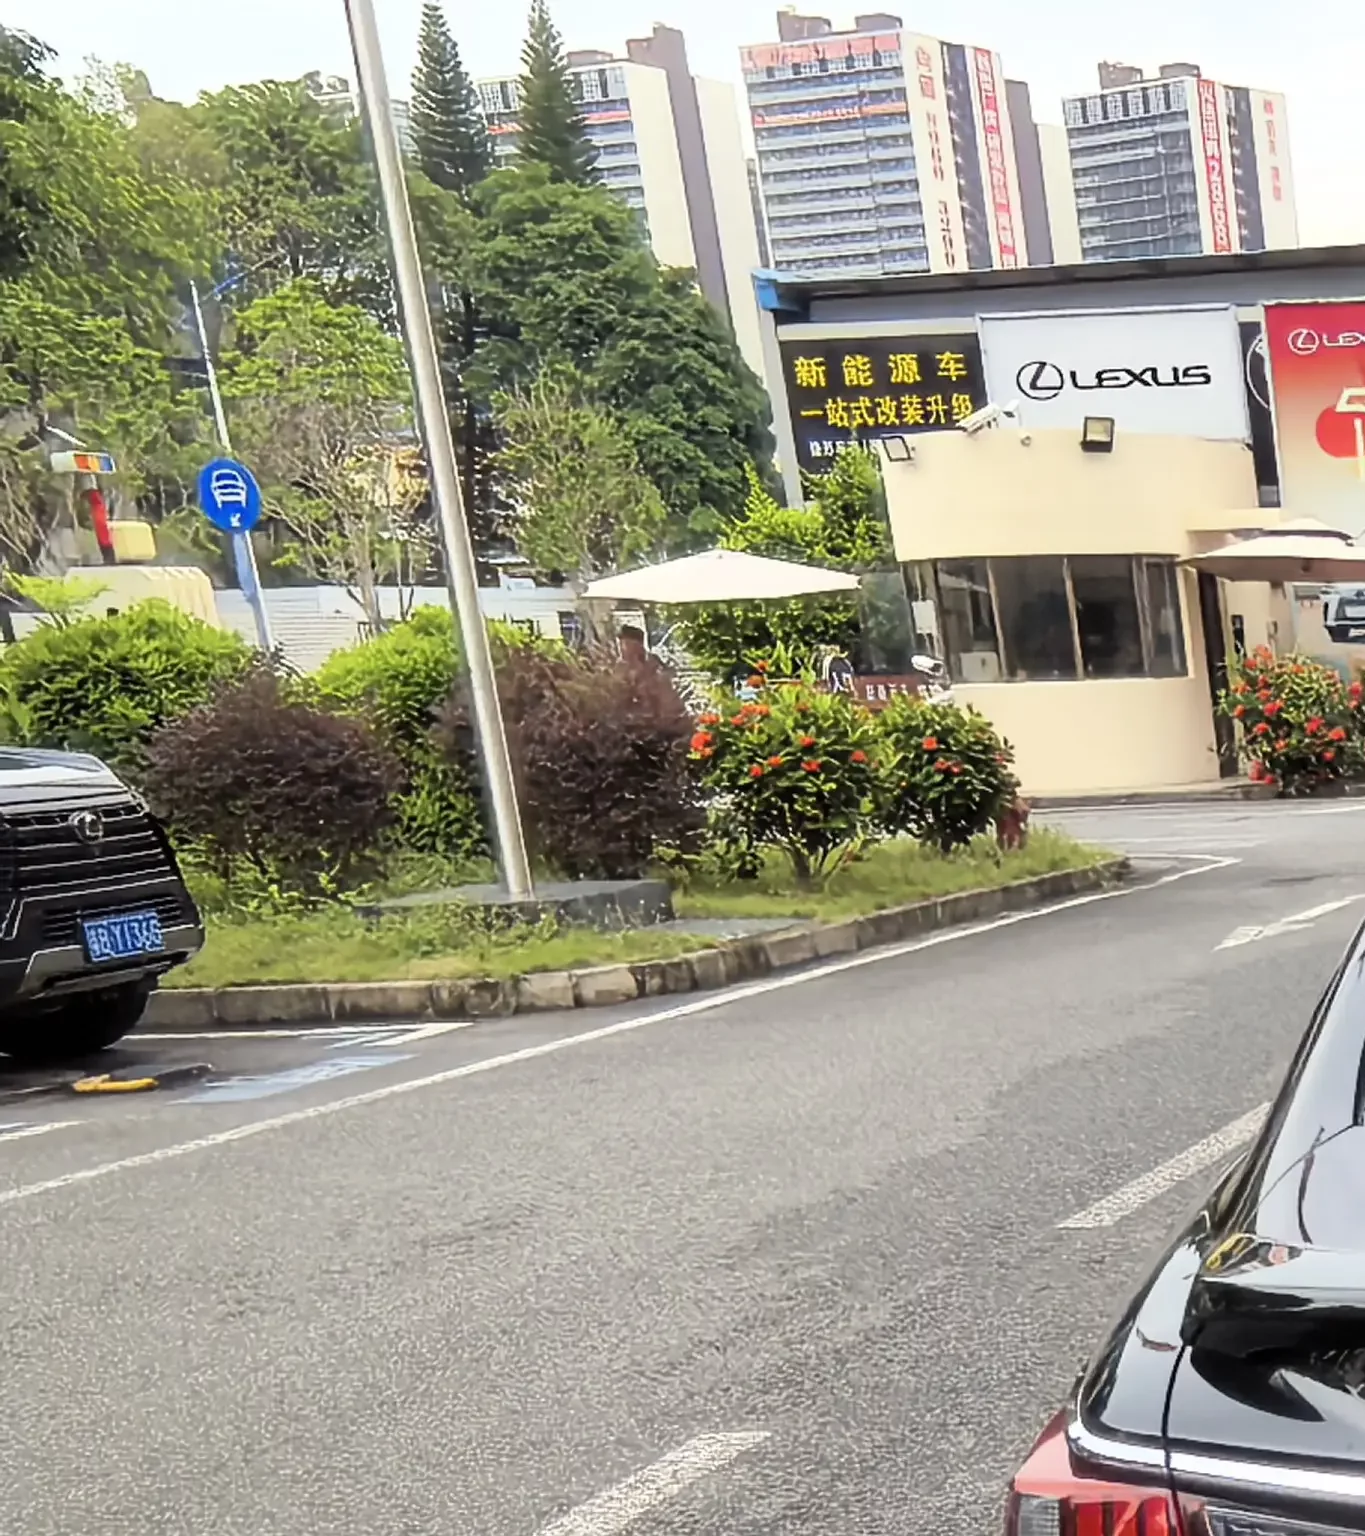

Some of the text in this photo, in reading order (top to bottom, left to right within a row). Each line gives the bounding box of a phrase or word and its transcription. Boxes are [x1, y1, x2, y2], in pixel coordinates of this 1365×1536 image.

[793, 351, 968, 387] 新能源车
[1070, 365, 1211, 389] LEXUS
[800, 393, 973, 428] 一站式改装升级
